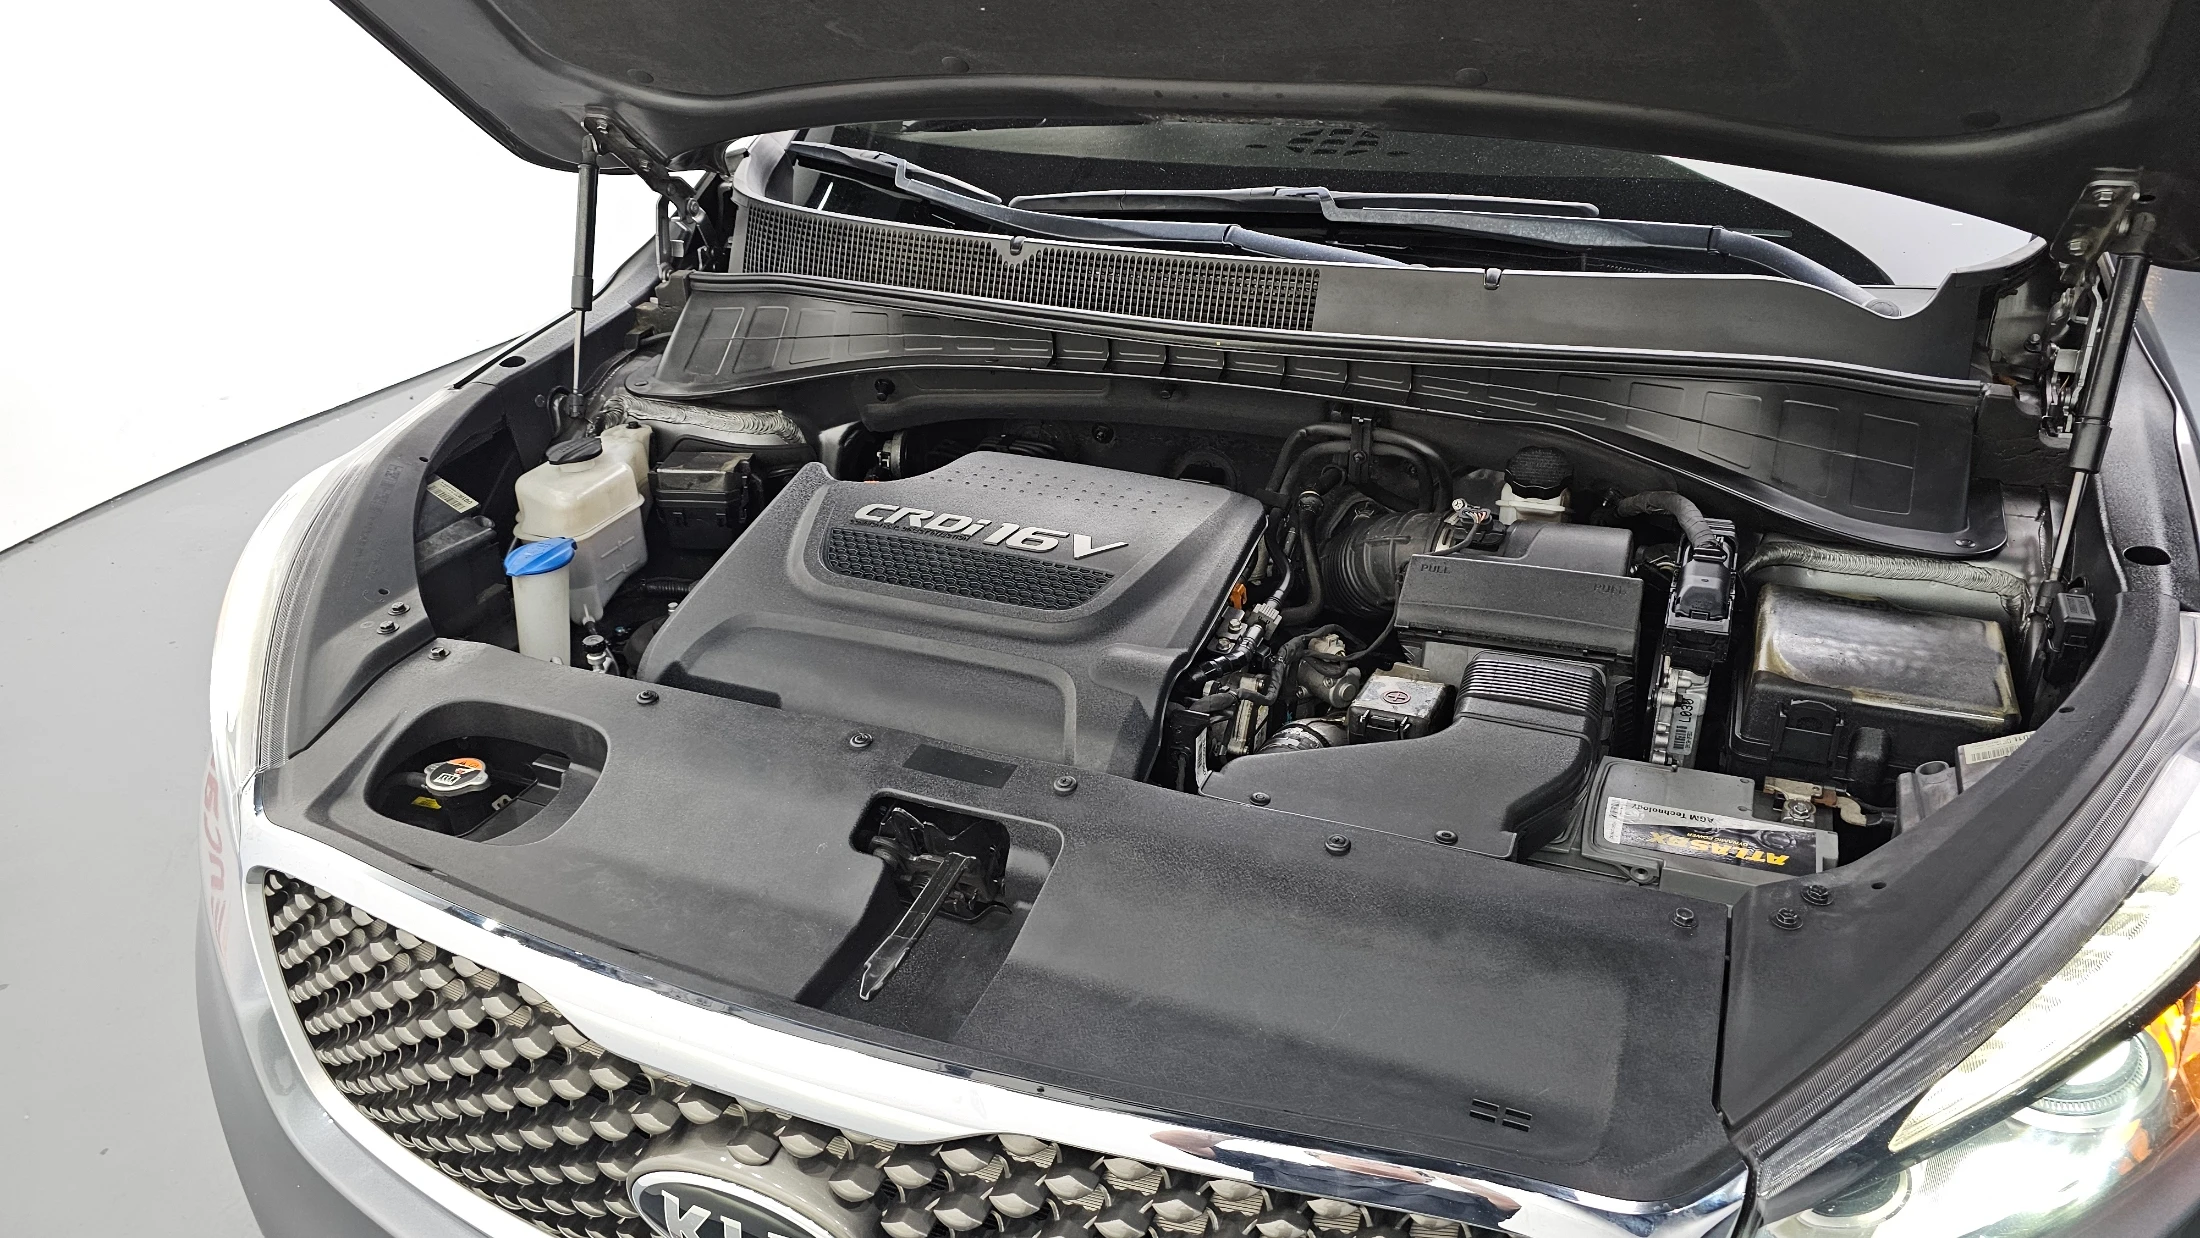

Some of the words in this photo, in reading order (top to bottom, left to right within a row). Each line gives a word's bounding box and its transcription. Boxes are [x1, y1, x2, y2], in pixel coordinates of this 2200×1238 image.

[854, 503, 992, 538] CRDi
[1420, 563, 1451, 575] PULL
[1689, 813, 1715, 824] AGM
[1686, 832, 1715, 841] POWER
[1714, 836, 1749, 848] DYNAMIC
[1649, 831, 1790, 866] ATLASBX
